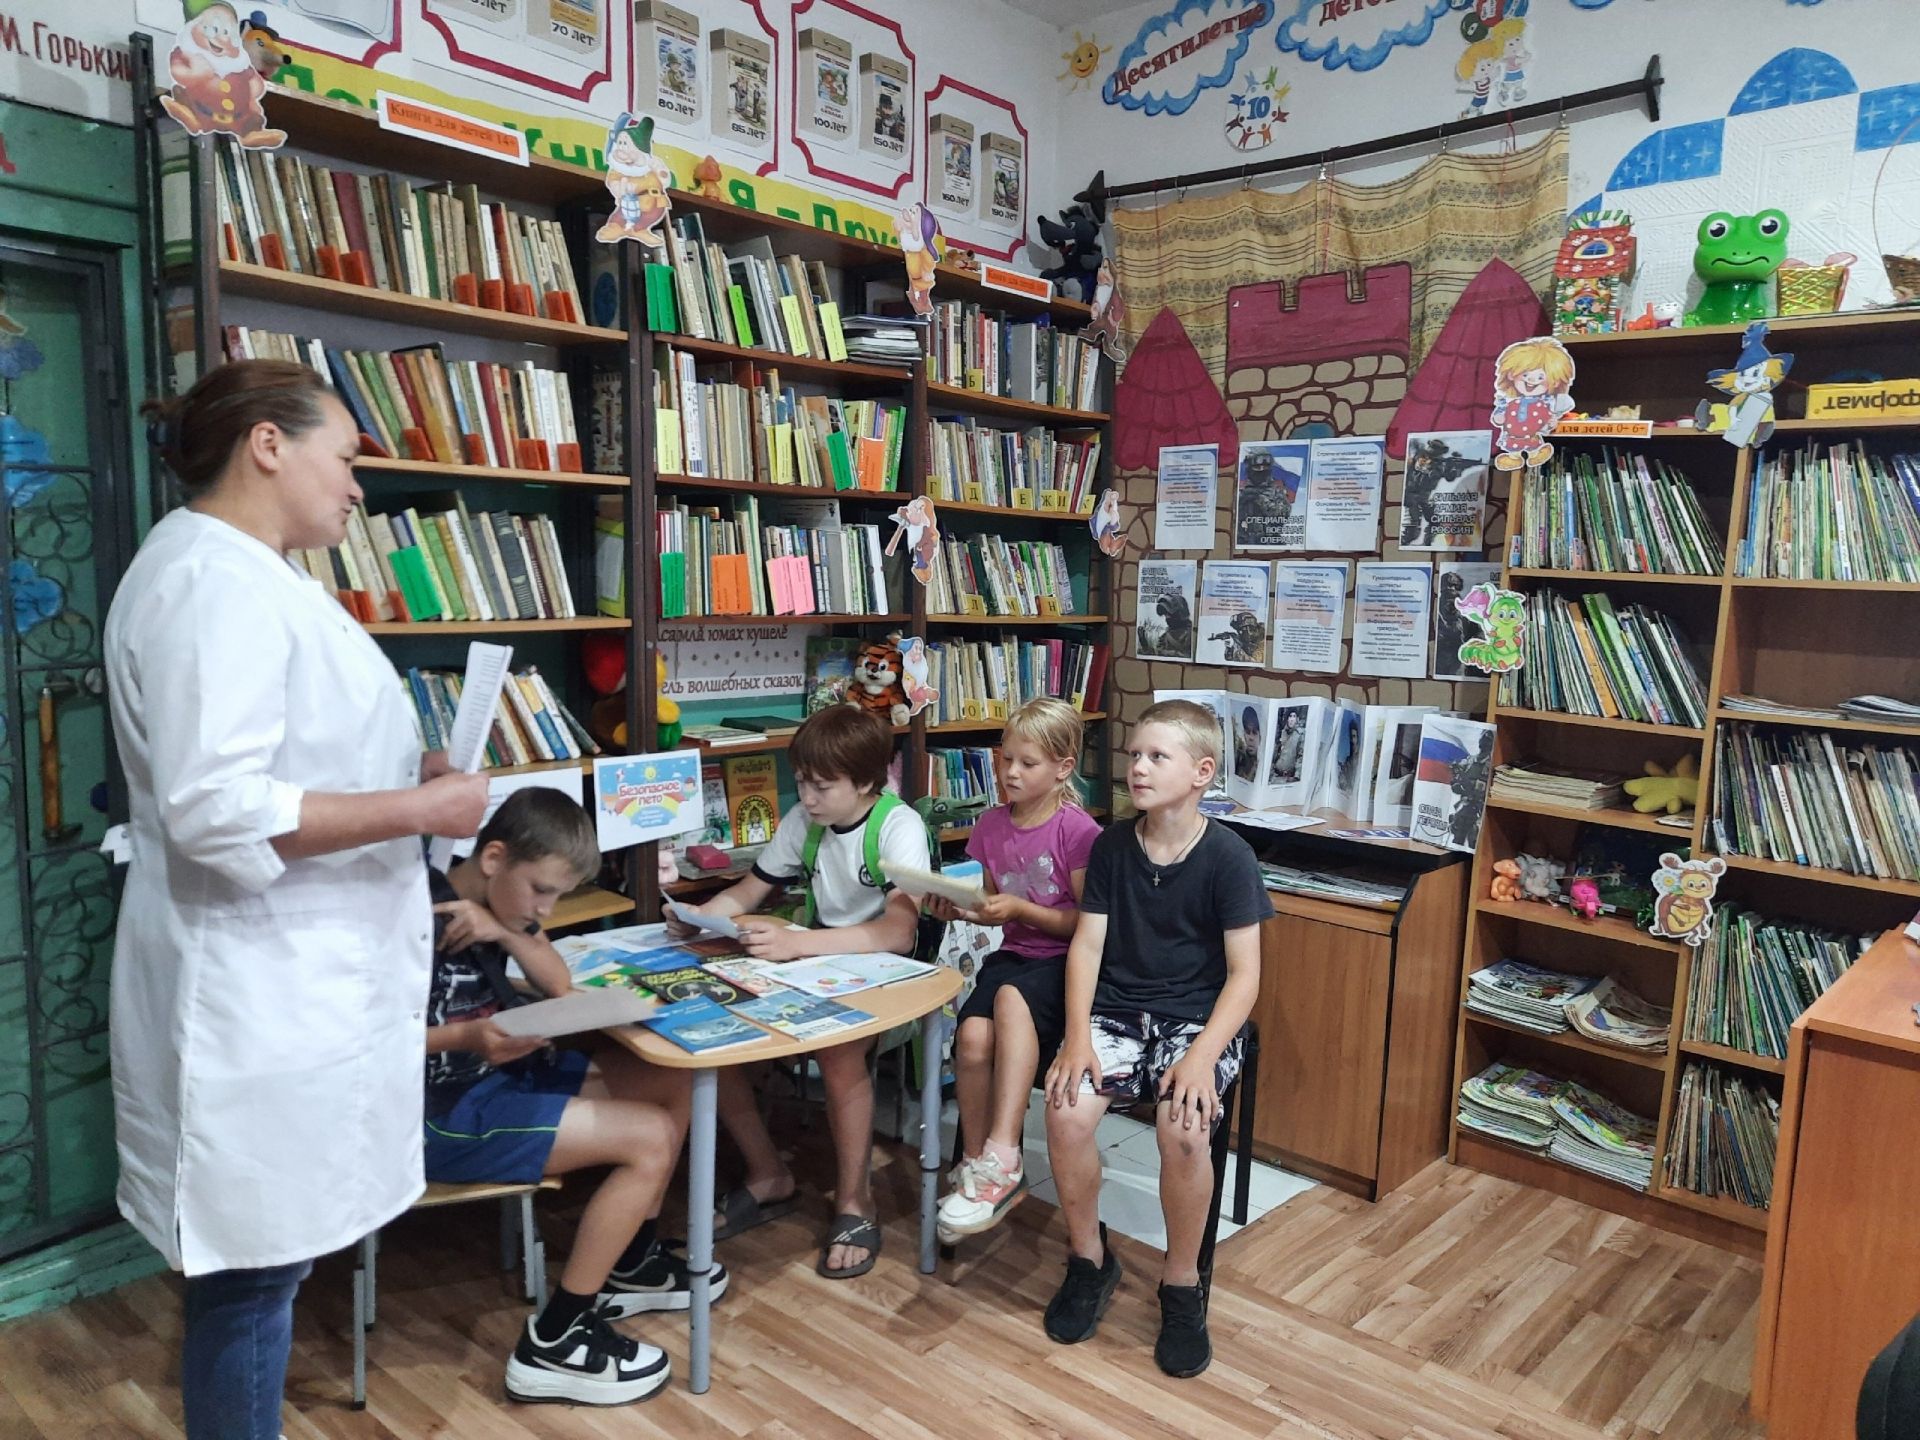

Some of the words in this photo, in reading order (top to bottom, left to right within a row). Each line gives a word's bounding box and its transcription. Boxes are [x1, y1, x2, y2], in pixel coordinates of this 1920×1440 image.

[552, 22, 568, 35] 70
[1111, 3, 1266, 99] Десятилетие
[1247, 96, 1271, 120] 10
[1245, 515, 1305, 525] СПЕЦИАЛЬНАЯ
[708, 628, 744, 642] юмах
[687, 670, 761, 694] волшебных
[763, 674, 804, 690] сказок
